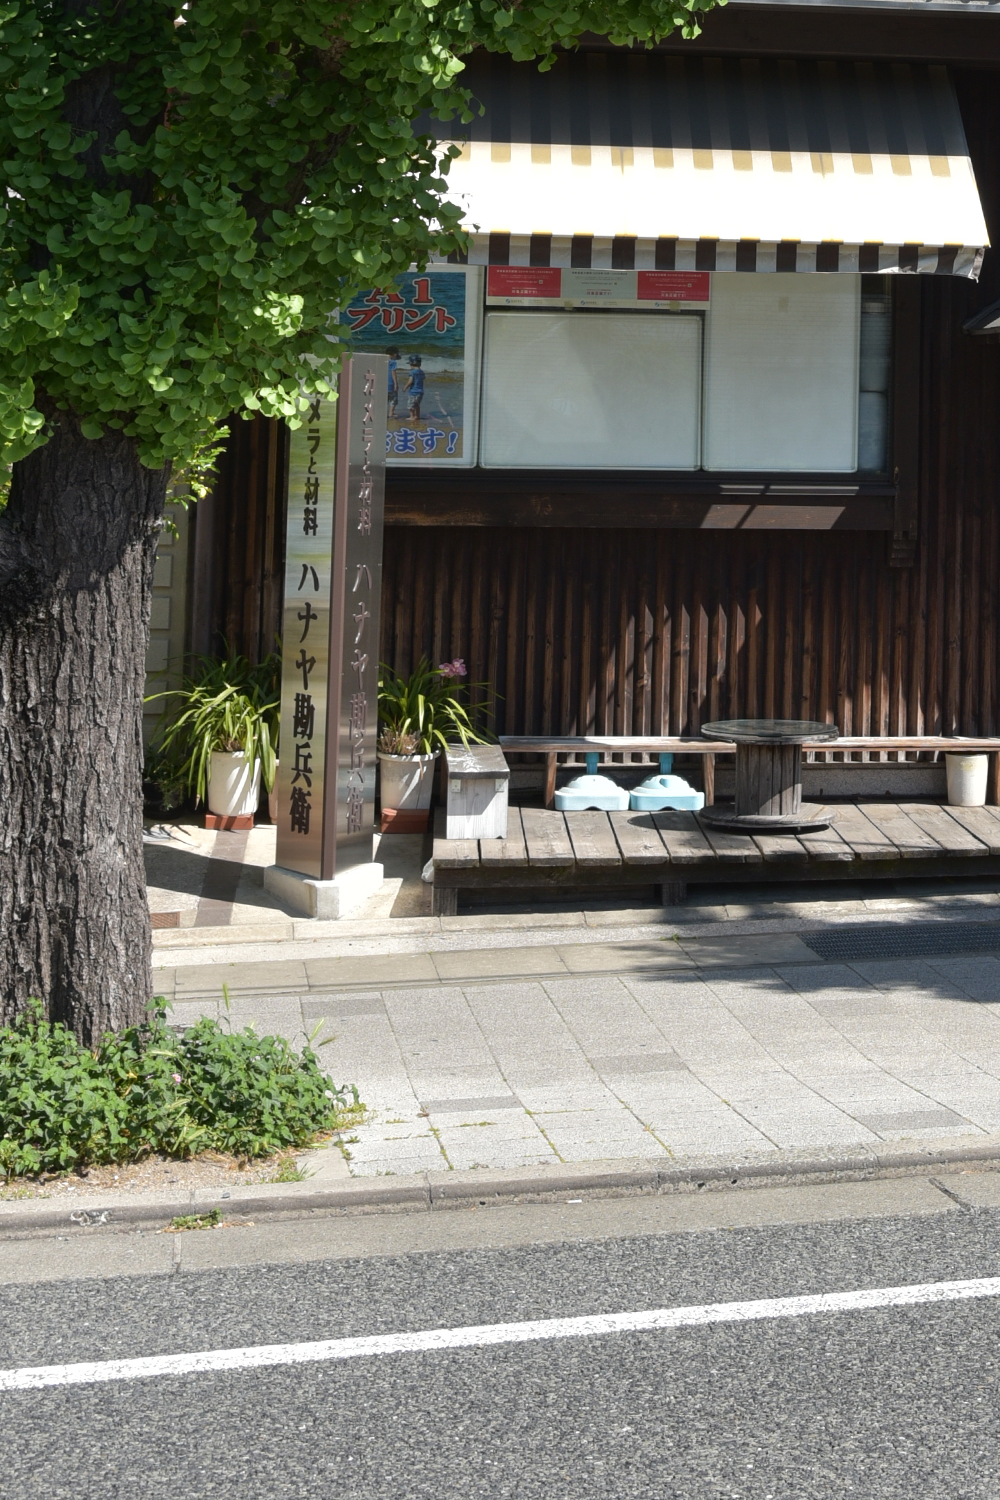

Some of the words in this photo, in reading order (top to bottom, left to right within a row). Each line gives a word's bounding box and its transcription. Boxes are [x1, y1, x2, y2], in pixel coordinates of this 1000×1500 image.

[346, 305, 456, 333] プリント
[303, 392, 321, 536] メラと材料
[357, 369, 376, 536] カメラと材料
[290, 563, 320, 835] ハナヤ勘兵衛
[347, 563, 373, 834] ハナヤ勘兵衛
